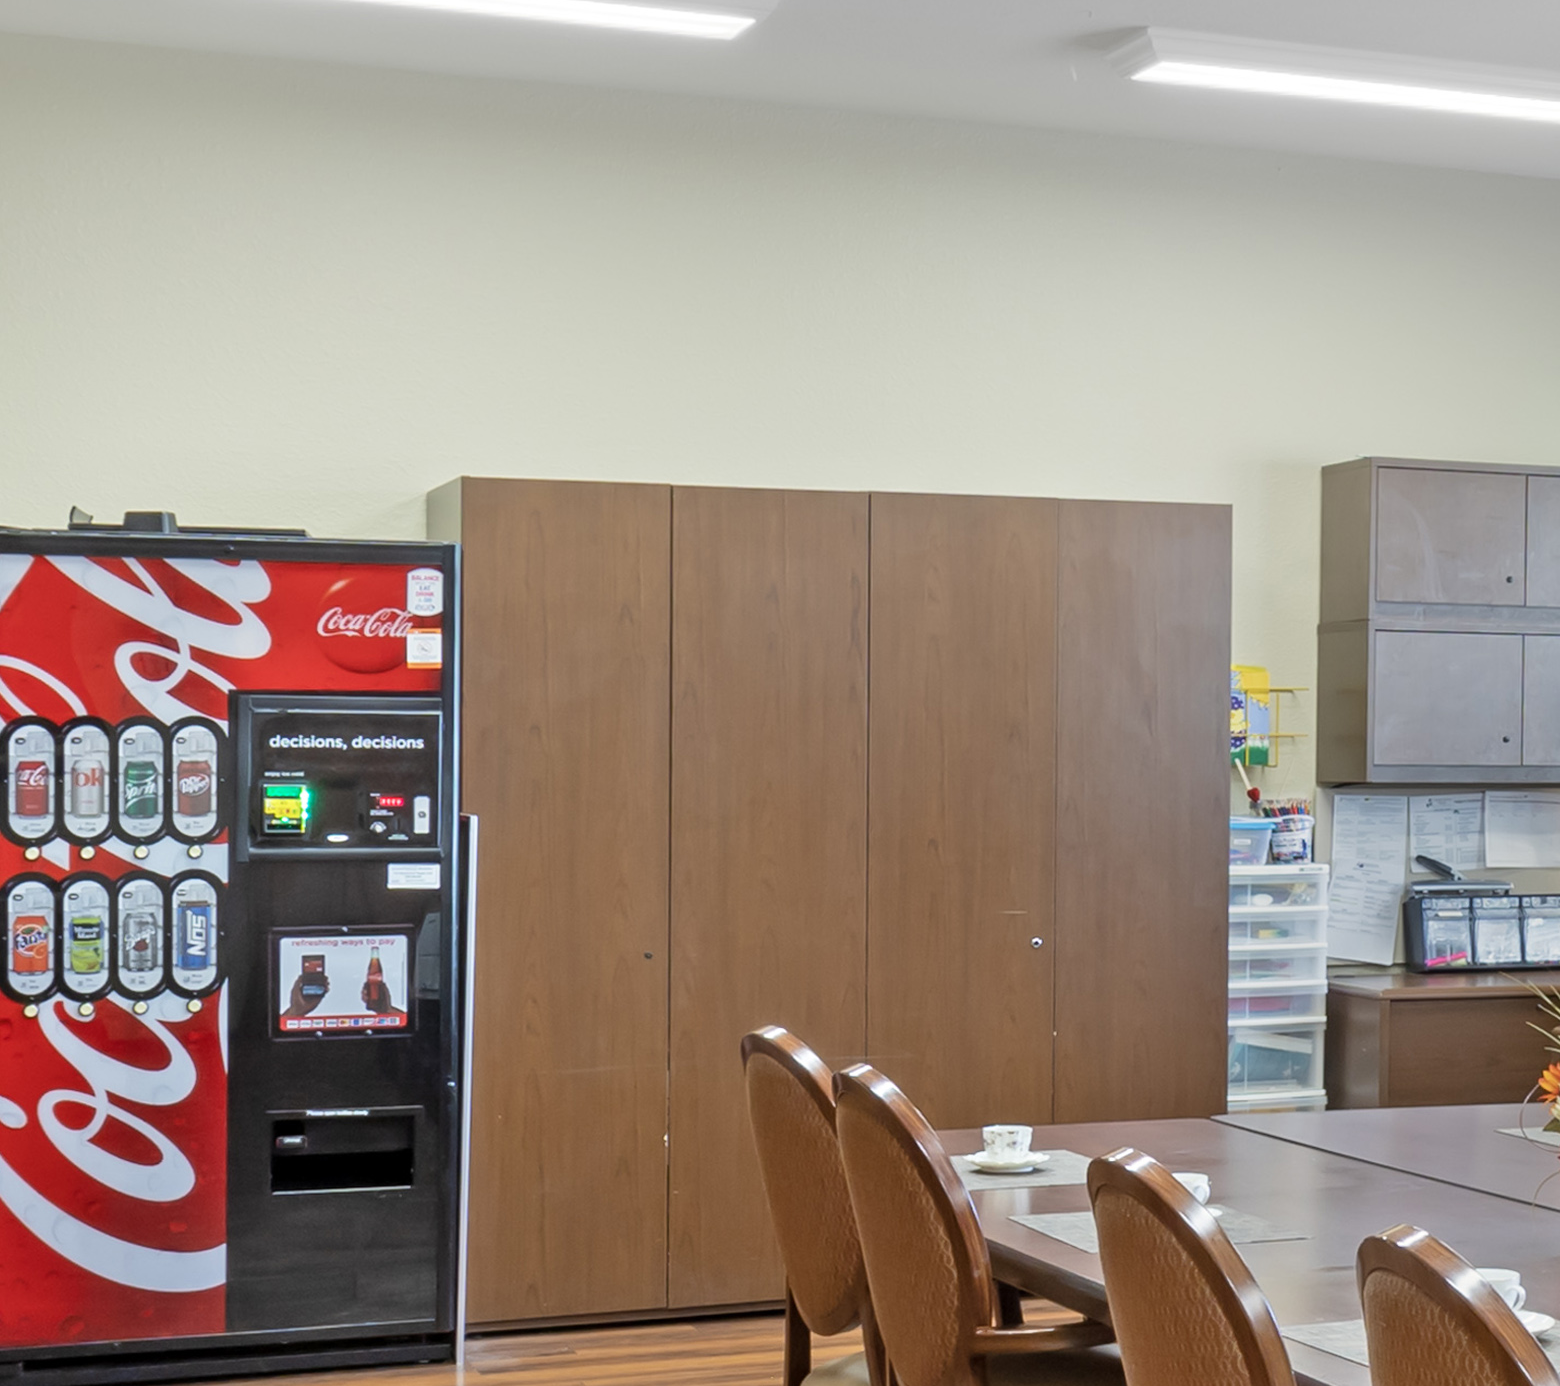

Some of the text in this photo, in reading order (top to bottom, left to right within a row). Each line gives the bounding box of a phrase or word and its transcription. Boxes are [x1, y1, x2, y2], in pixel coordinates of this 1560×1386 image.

[317, 607, 413, 637] Coca-Cola
[269, 734, 425, 750] decisions, decisions
[186, 909, 207, 957] NOS
[291, 939, 339, 948] refreshing
[341, 939, 364, 947] ways
